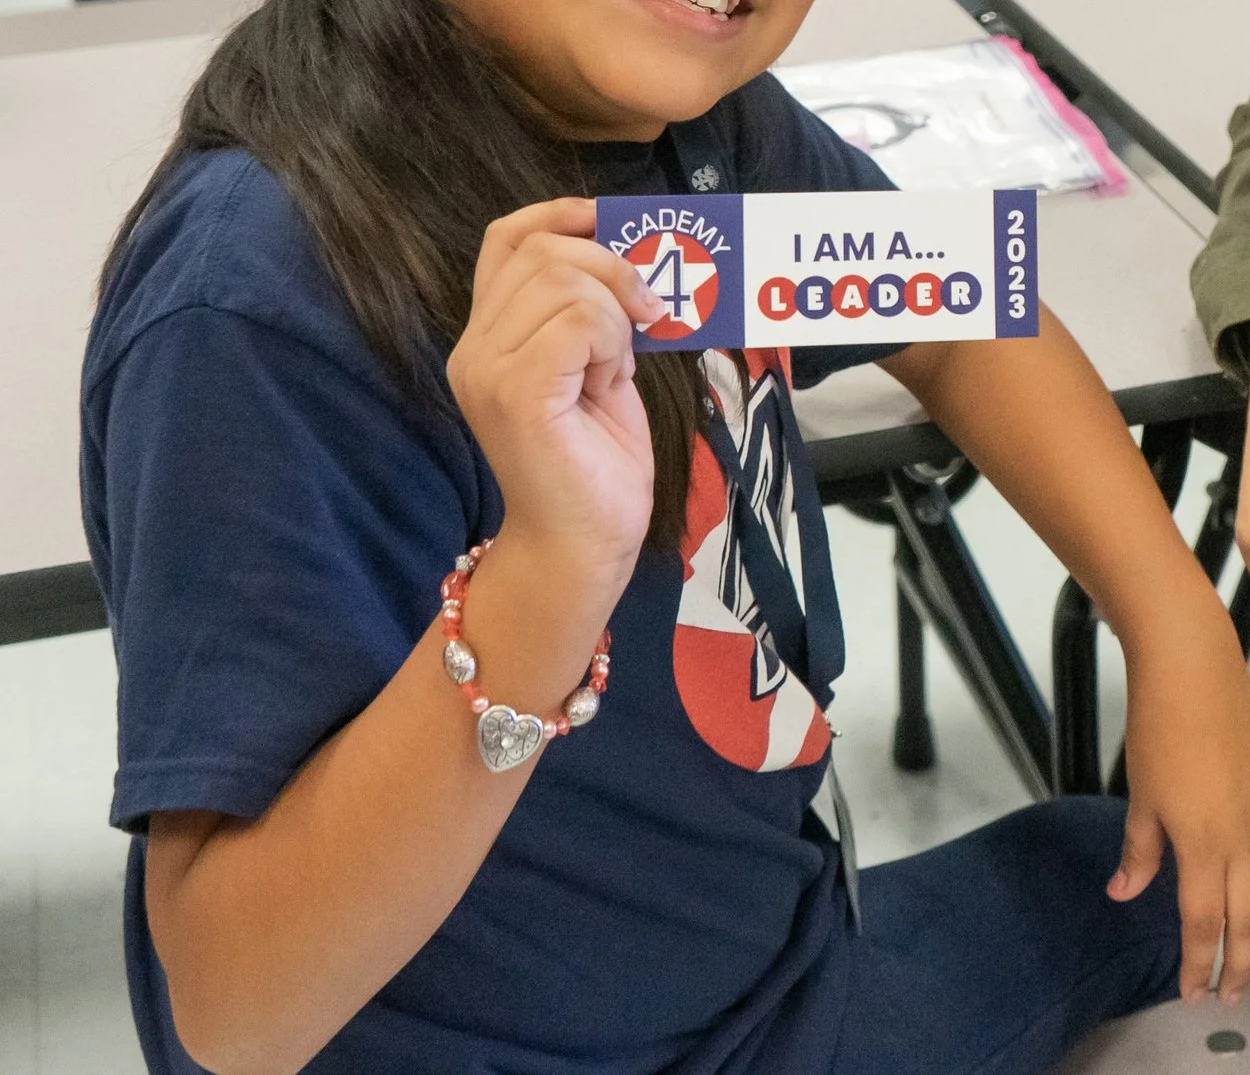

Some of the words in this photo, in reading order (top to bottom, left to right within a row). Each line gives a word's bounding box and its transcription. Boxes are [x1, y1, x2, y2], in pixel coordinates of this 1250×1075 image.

[608, 208, 732, 259] ACADEMY
[794, 234, 801, 262] I
[813, 232, 875, 262] AM
[886, 231, 945, 260] A...
[645, 248, 691, 318] 4
[1006, 209, 1026, 319] 2023
[770, 280, 971, 312] LEADER
